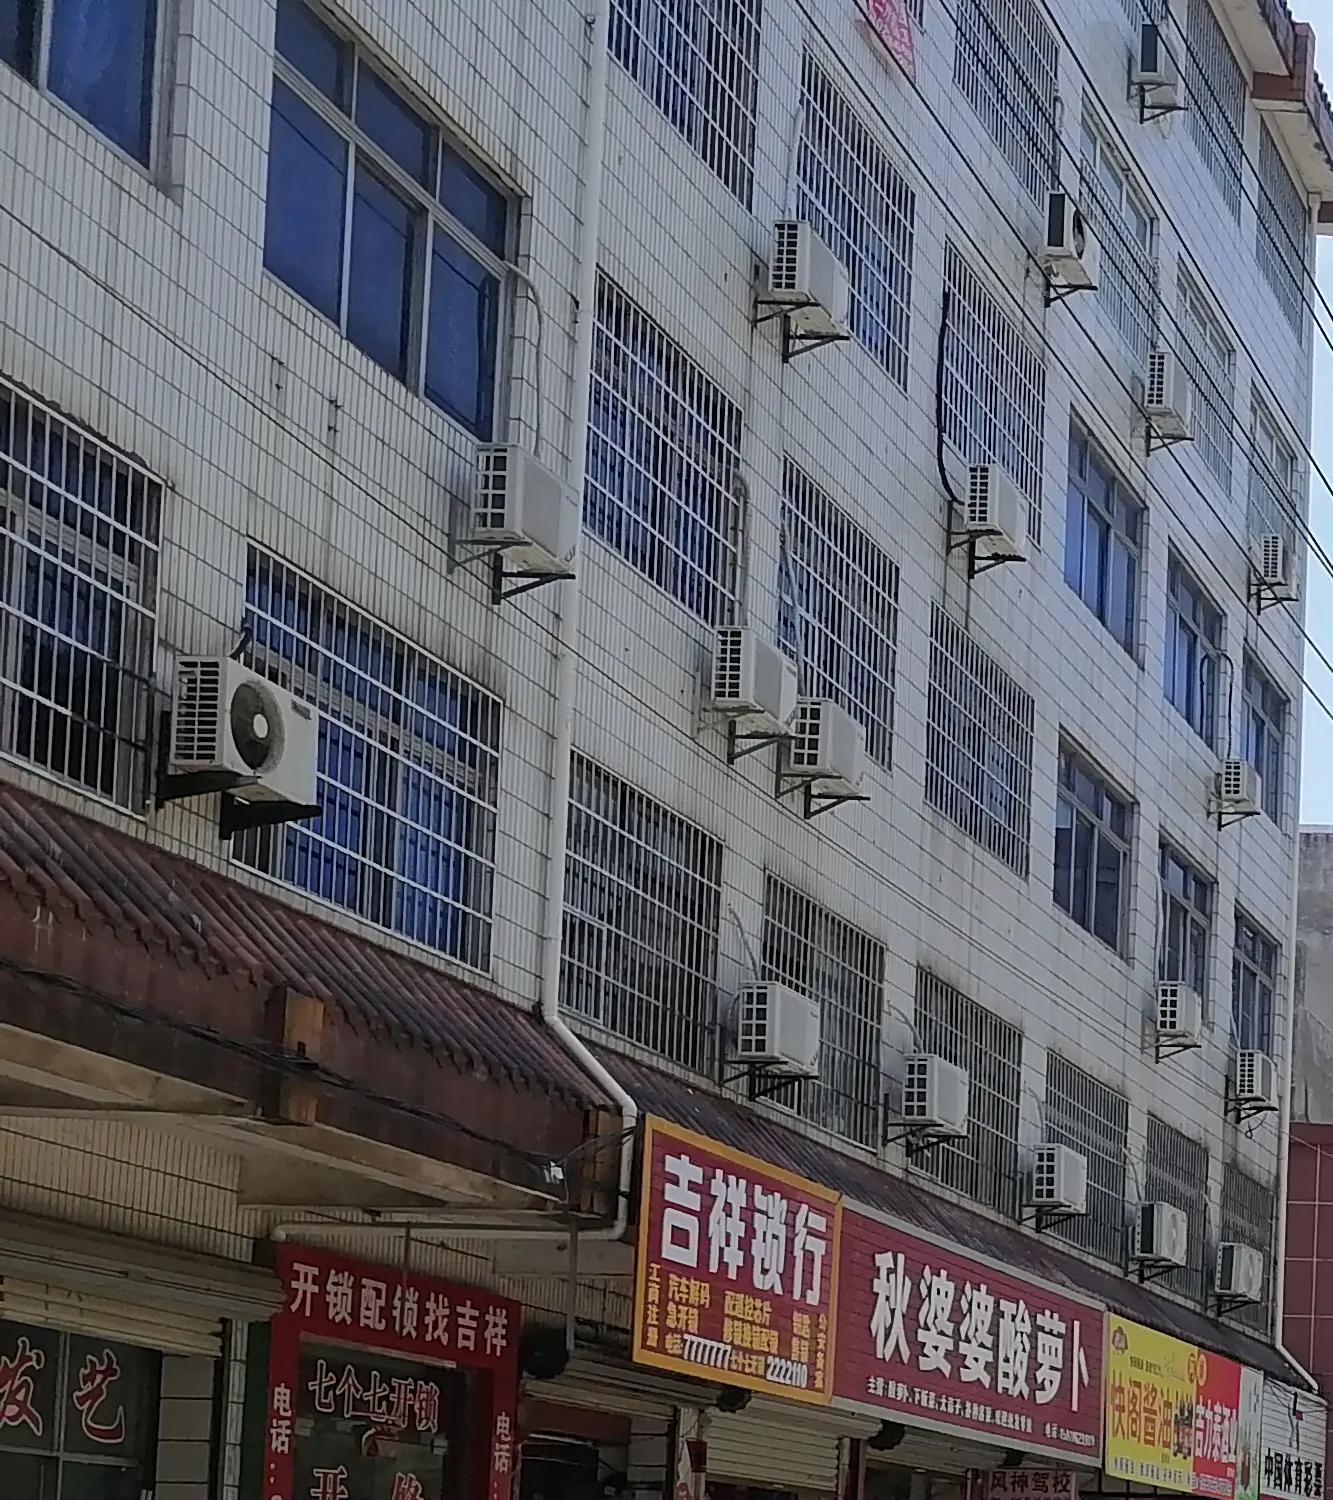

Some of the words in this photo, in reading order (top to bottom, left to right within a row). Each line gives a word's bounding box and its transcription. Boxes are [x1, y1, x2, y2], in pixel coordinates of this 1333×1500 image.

[661, 1153, 828, 1306] 吉祥锁行
[290, 1262, 508, 1357] 开锁配锁找吉祥
[870, 1251, 1090, 1412] 秋婆婆酸萝卜
[307, 1358, 441, 1434] 七个七开锁
[990, 1470, 1072, 1494] 风神驾校
[1263, 1447, 1323, 1498] 中国体育彩票
